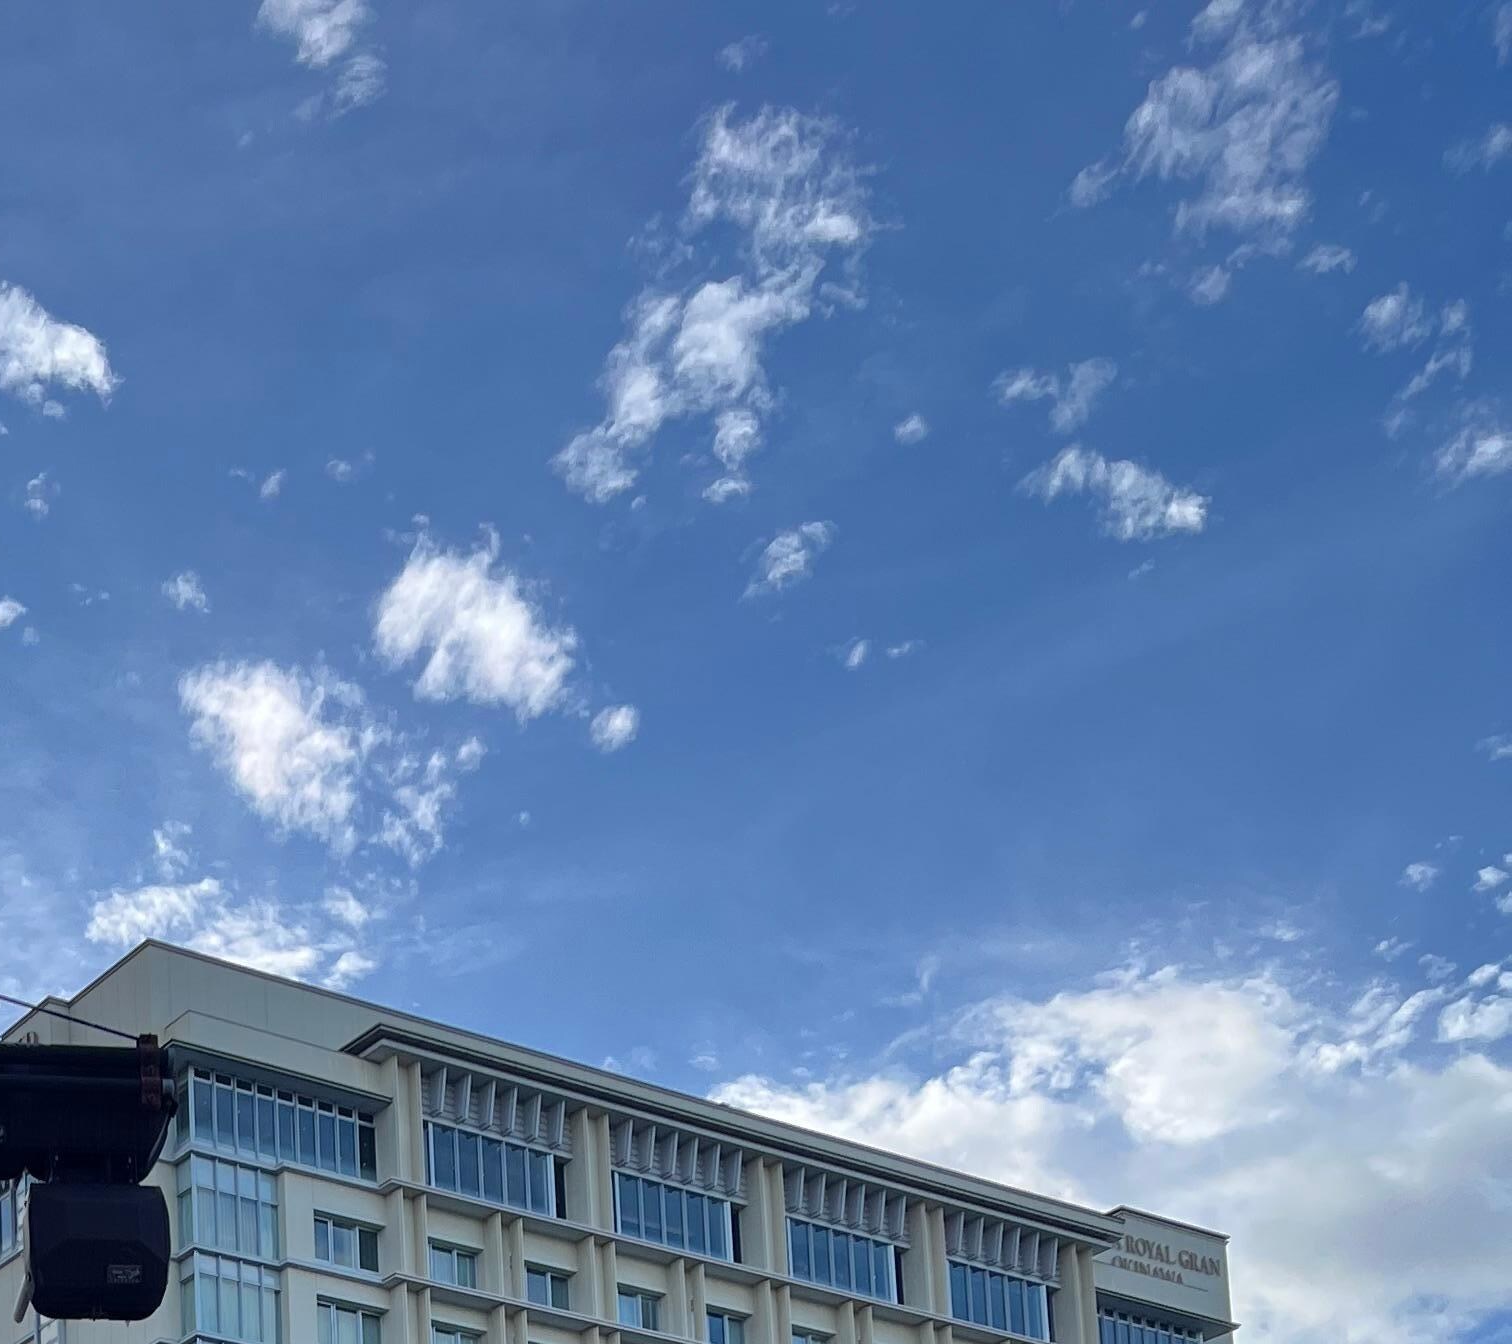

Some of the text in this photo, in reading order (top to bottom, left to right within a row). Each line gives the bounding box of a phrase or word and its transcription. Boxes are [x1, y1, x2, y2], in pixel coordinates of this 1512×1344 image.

[1112, 1255, 1184, 1285] OKINAWA
[1125, 1234, 1221, 1276] ROYAL GRAN
